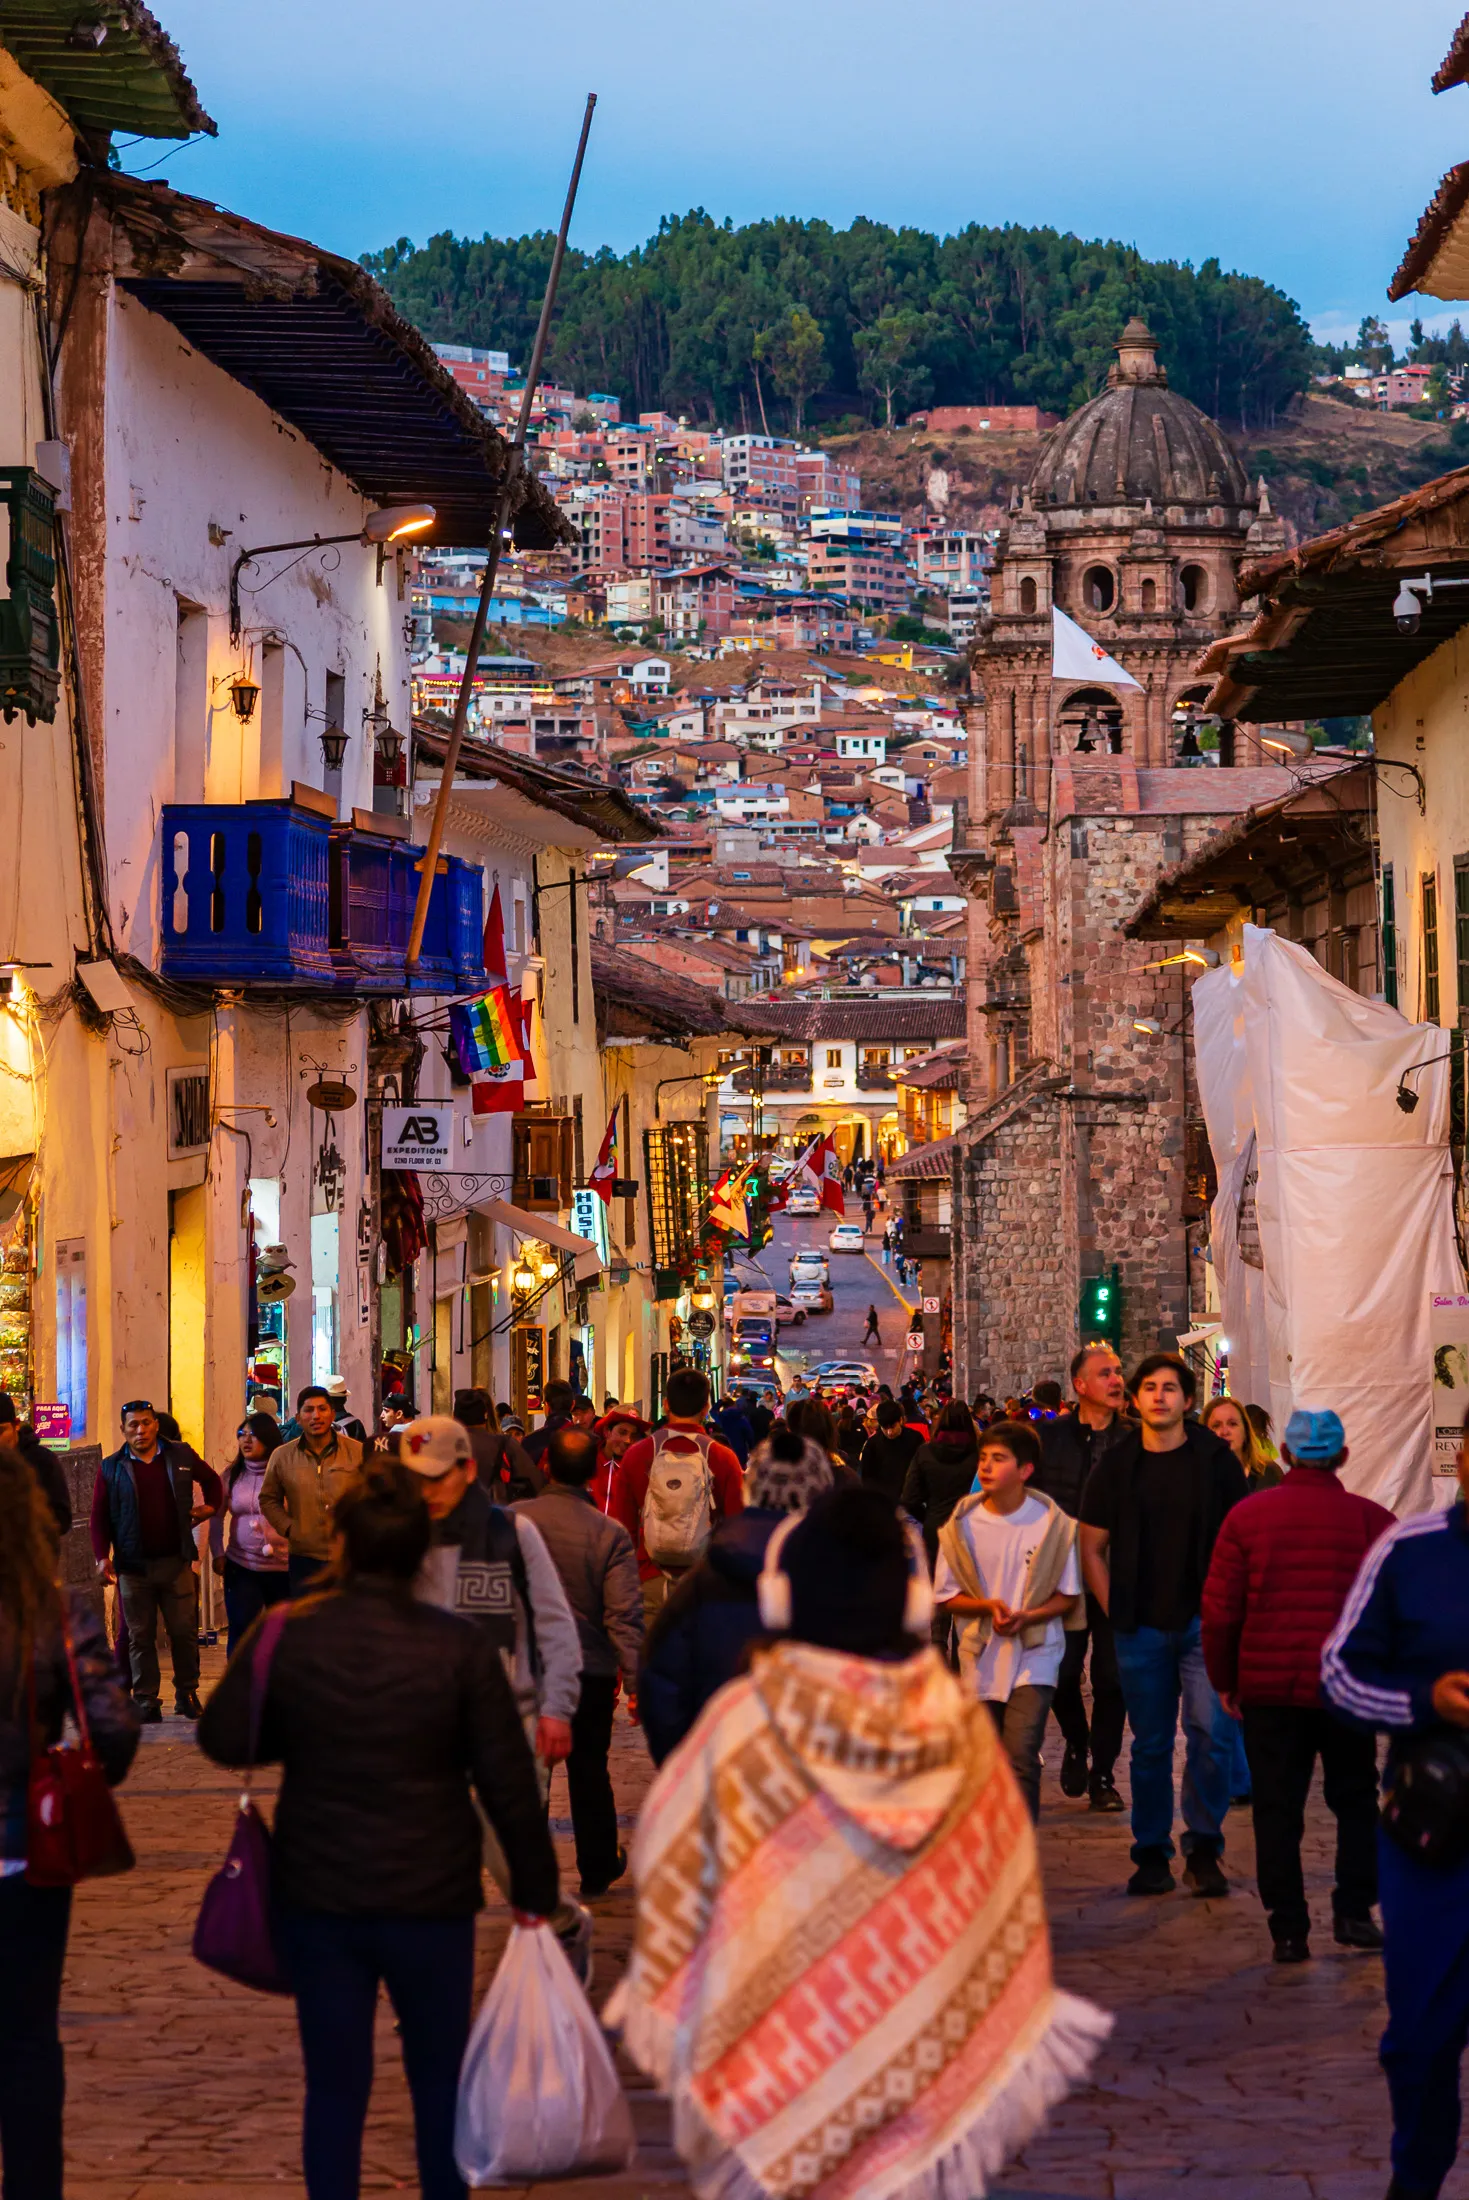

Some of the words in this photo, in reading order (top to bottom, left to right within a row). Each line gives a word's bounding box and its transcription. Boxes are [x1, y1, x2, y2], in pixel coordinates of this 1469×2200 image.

[398, 1116, 439, 1144] AB
[387, 1147, 449, 1155] EXPEDITIONS
[408, 1157, 425, 1165] FLOOR
